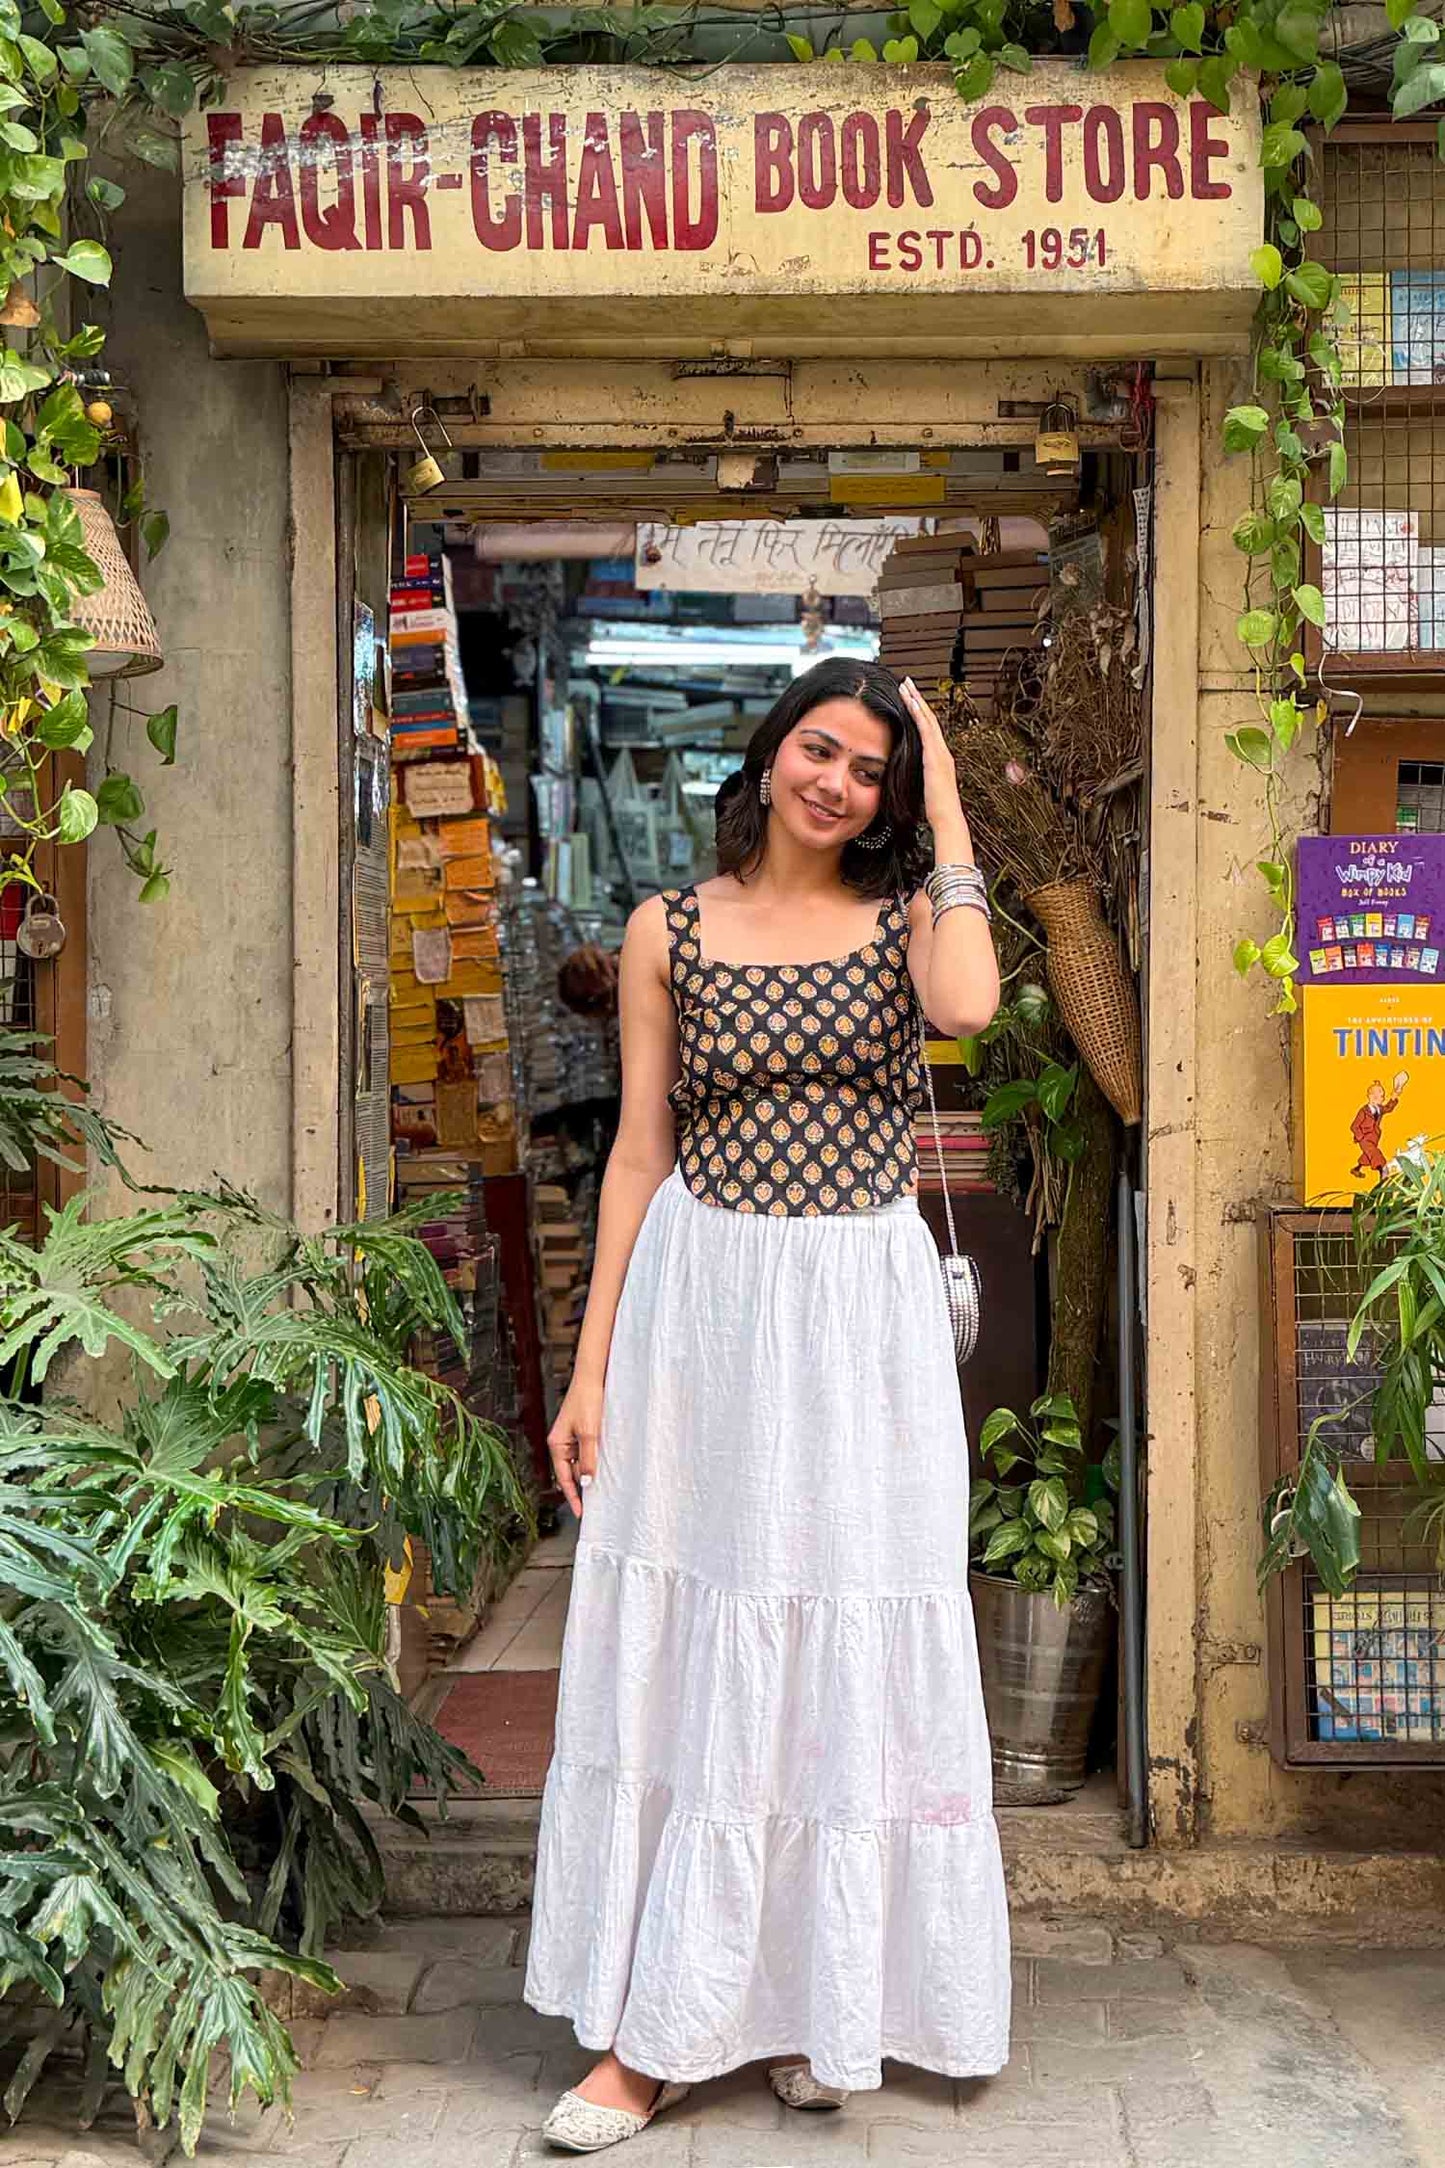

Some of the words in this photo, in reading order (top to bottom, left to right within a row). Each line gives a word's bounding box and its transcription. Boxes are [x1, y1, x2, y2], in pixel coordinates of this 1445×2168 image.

[206, 110, 719, 251] FAQIR-CHAND
[755, 106, 933, 213] BOOK
[972, 102, 1232, 209] STORE
[868, 230, 995, 271] ESTD.
[1022, 228, 1105, 270] 1951
[1350, 841, 1399, 854] DIARY
[1335, 864, 1386, 887] Wimpy
[1387, 862, 1413, 883] Kid
[1332, 1028, 1445, 1056] TINTIN
